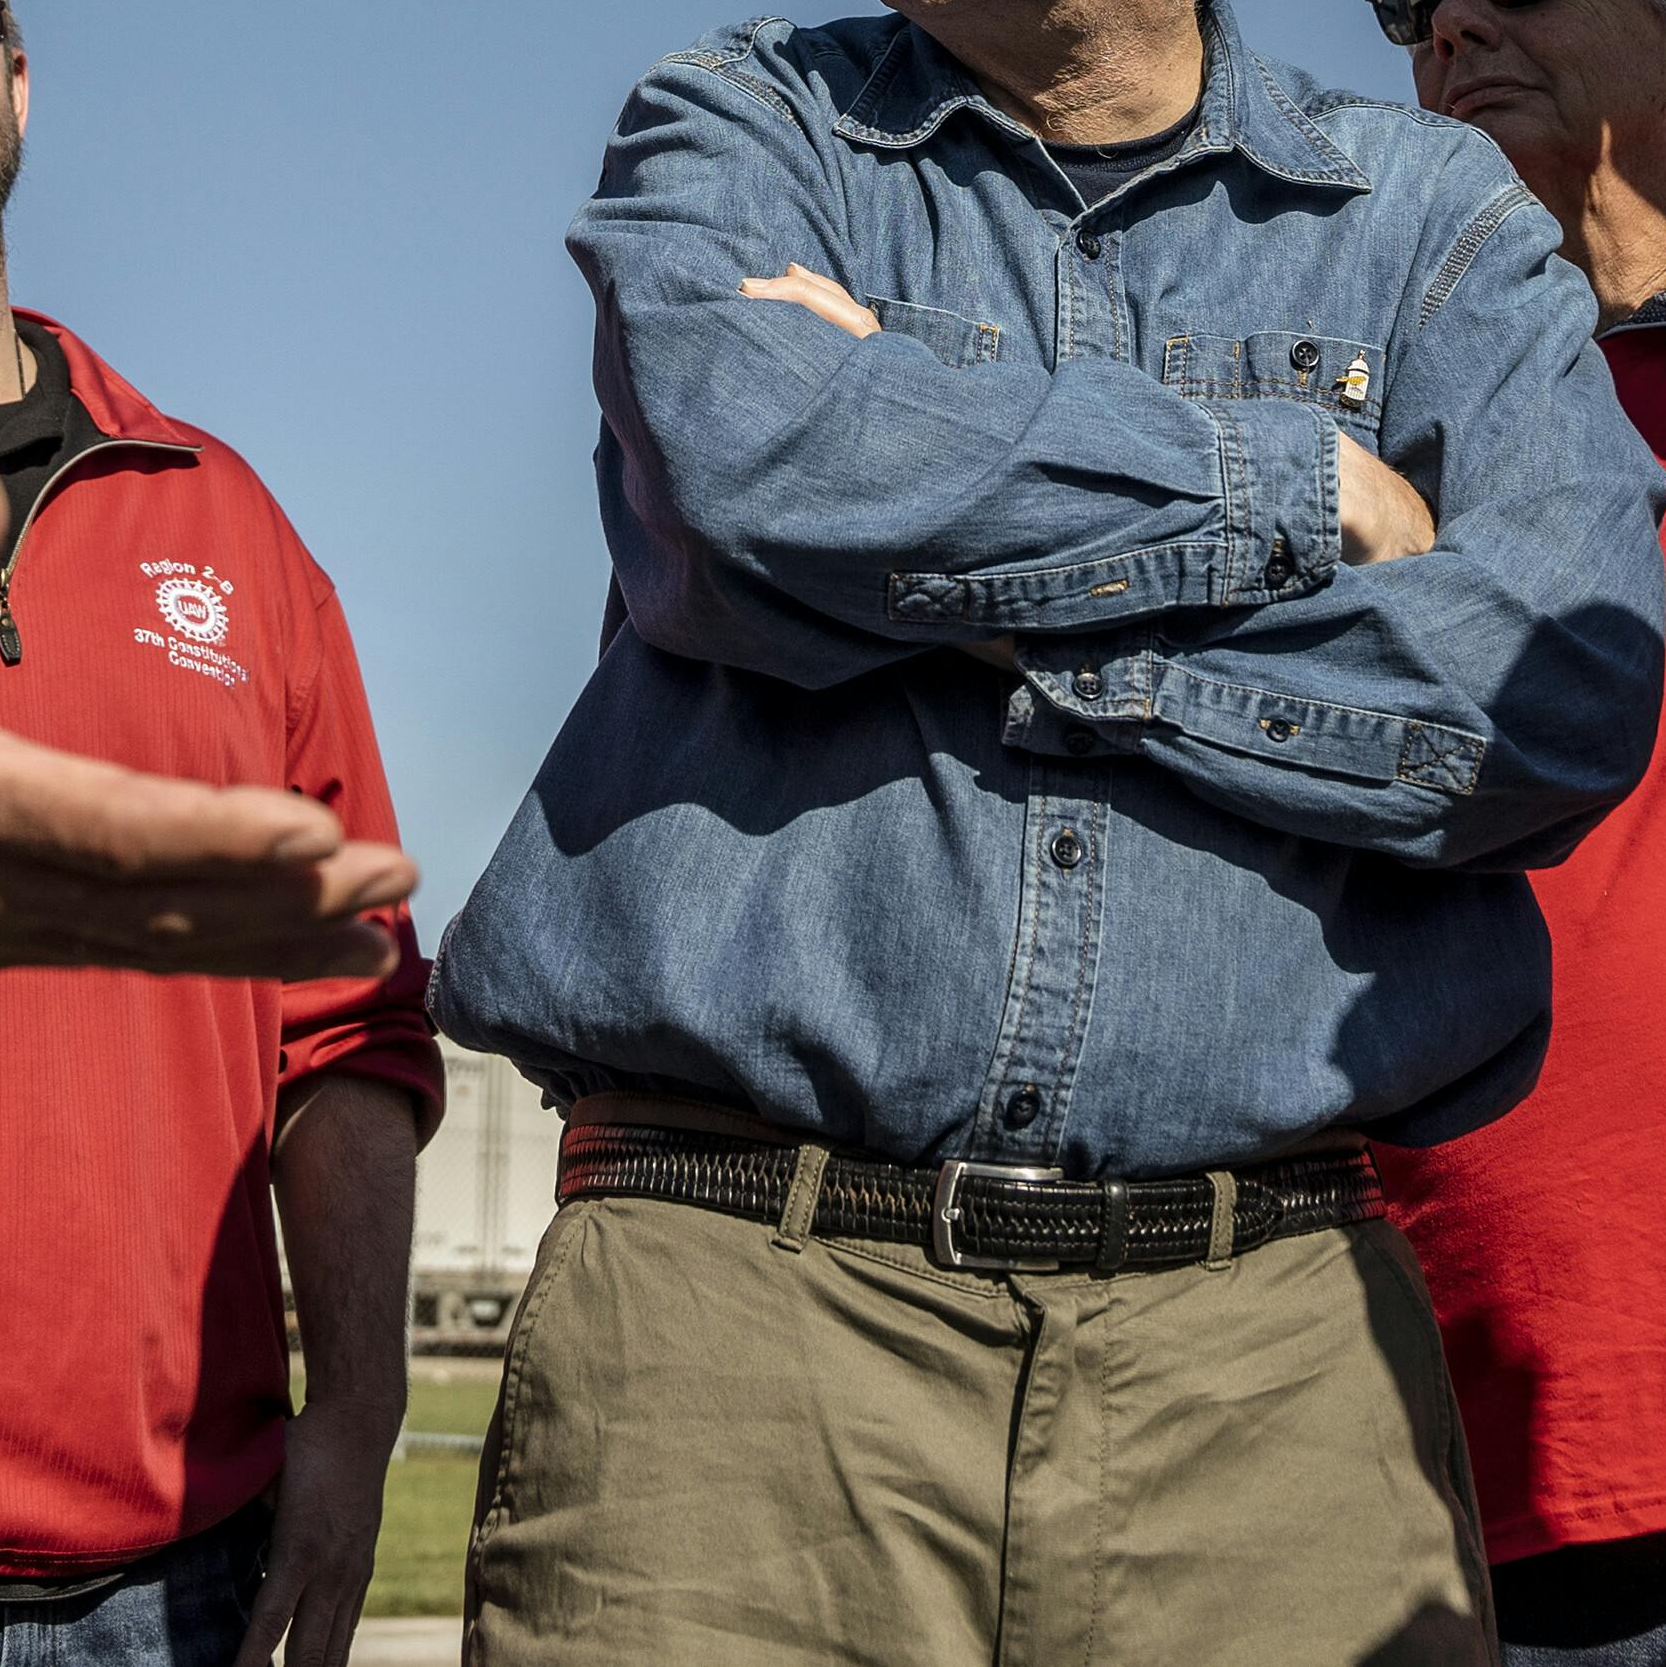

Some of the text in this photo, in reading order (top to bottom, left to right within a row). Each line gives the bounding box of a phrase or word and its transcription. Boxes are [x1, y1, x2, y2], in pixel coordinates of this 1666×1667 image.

[140, 558, 196, 578] Region
[178, 600, 208, 620] UAW
[134, 628, 165, 648] 37th
